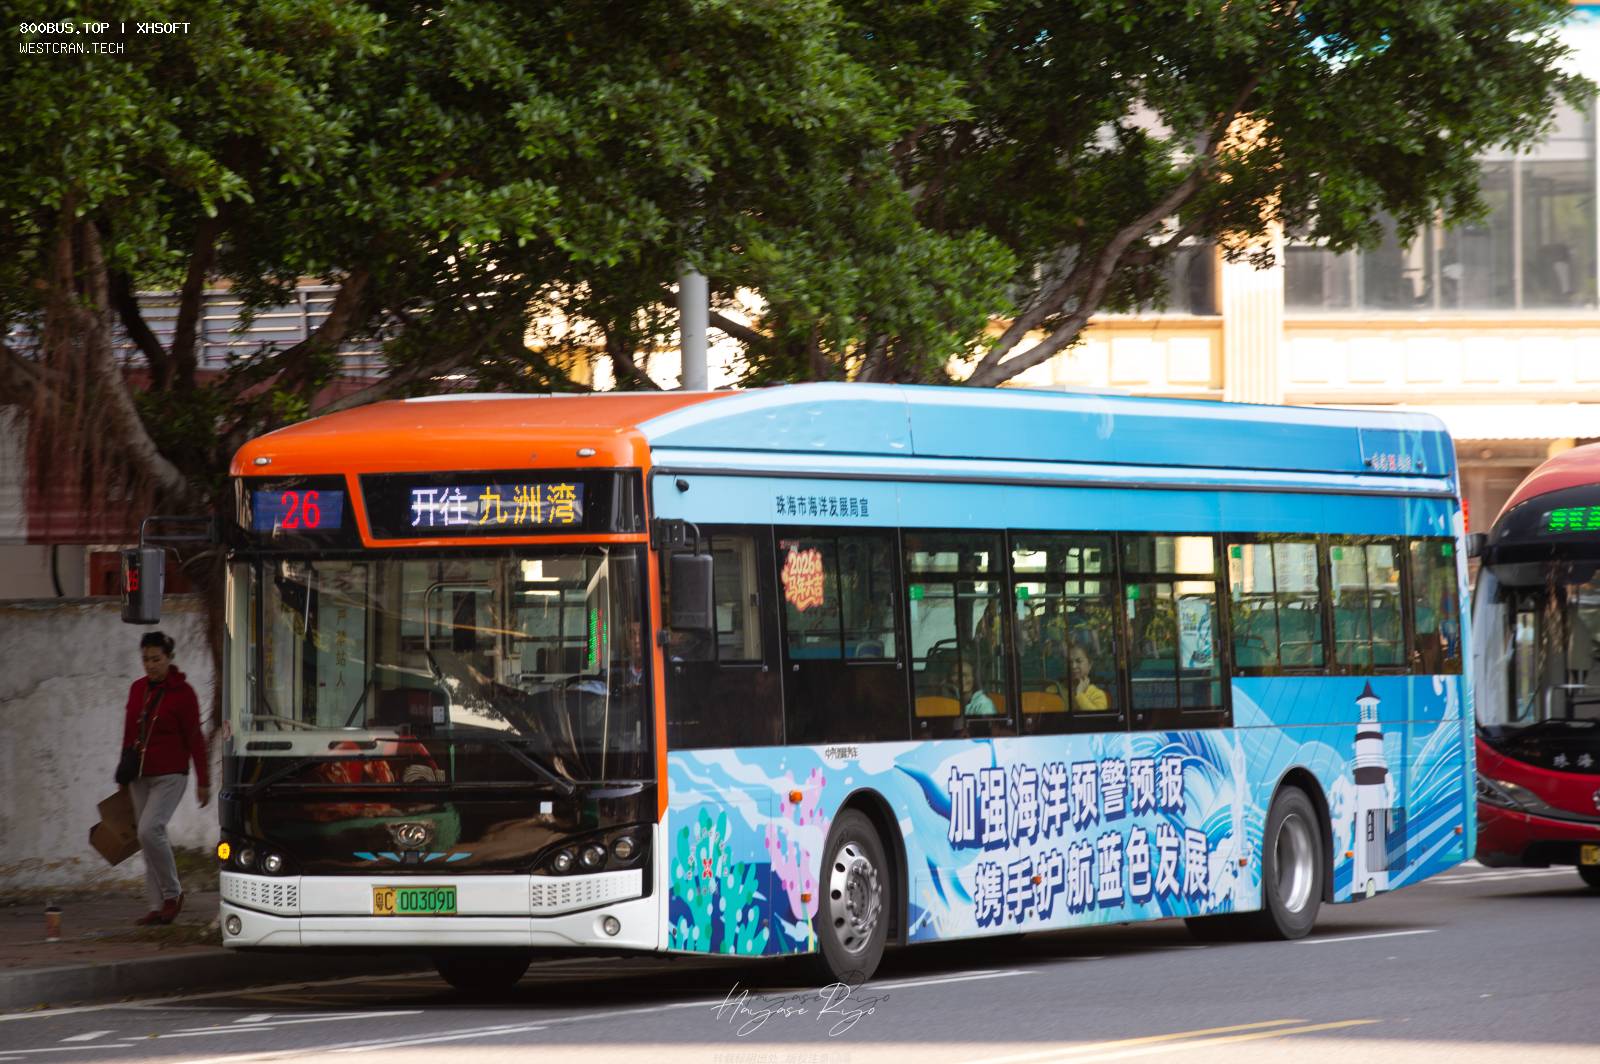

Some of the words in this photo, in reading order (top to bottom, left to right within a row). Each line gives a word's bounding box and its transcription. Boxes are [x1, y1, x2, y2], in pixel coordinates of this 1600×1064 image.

[281, 490, 320, 528] 26
[776, 496, 869, 517] 珠海市海洋发展局宣
[789, 550, 815, 574] 2026
[948, 757, 1186, 850] 加强海洋预警预报
[974, 824, 1215, 928] 携手护航蓝色发展
